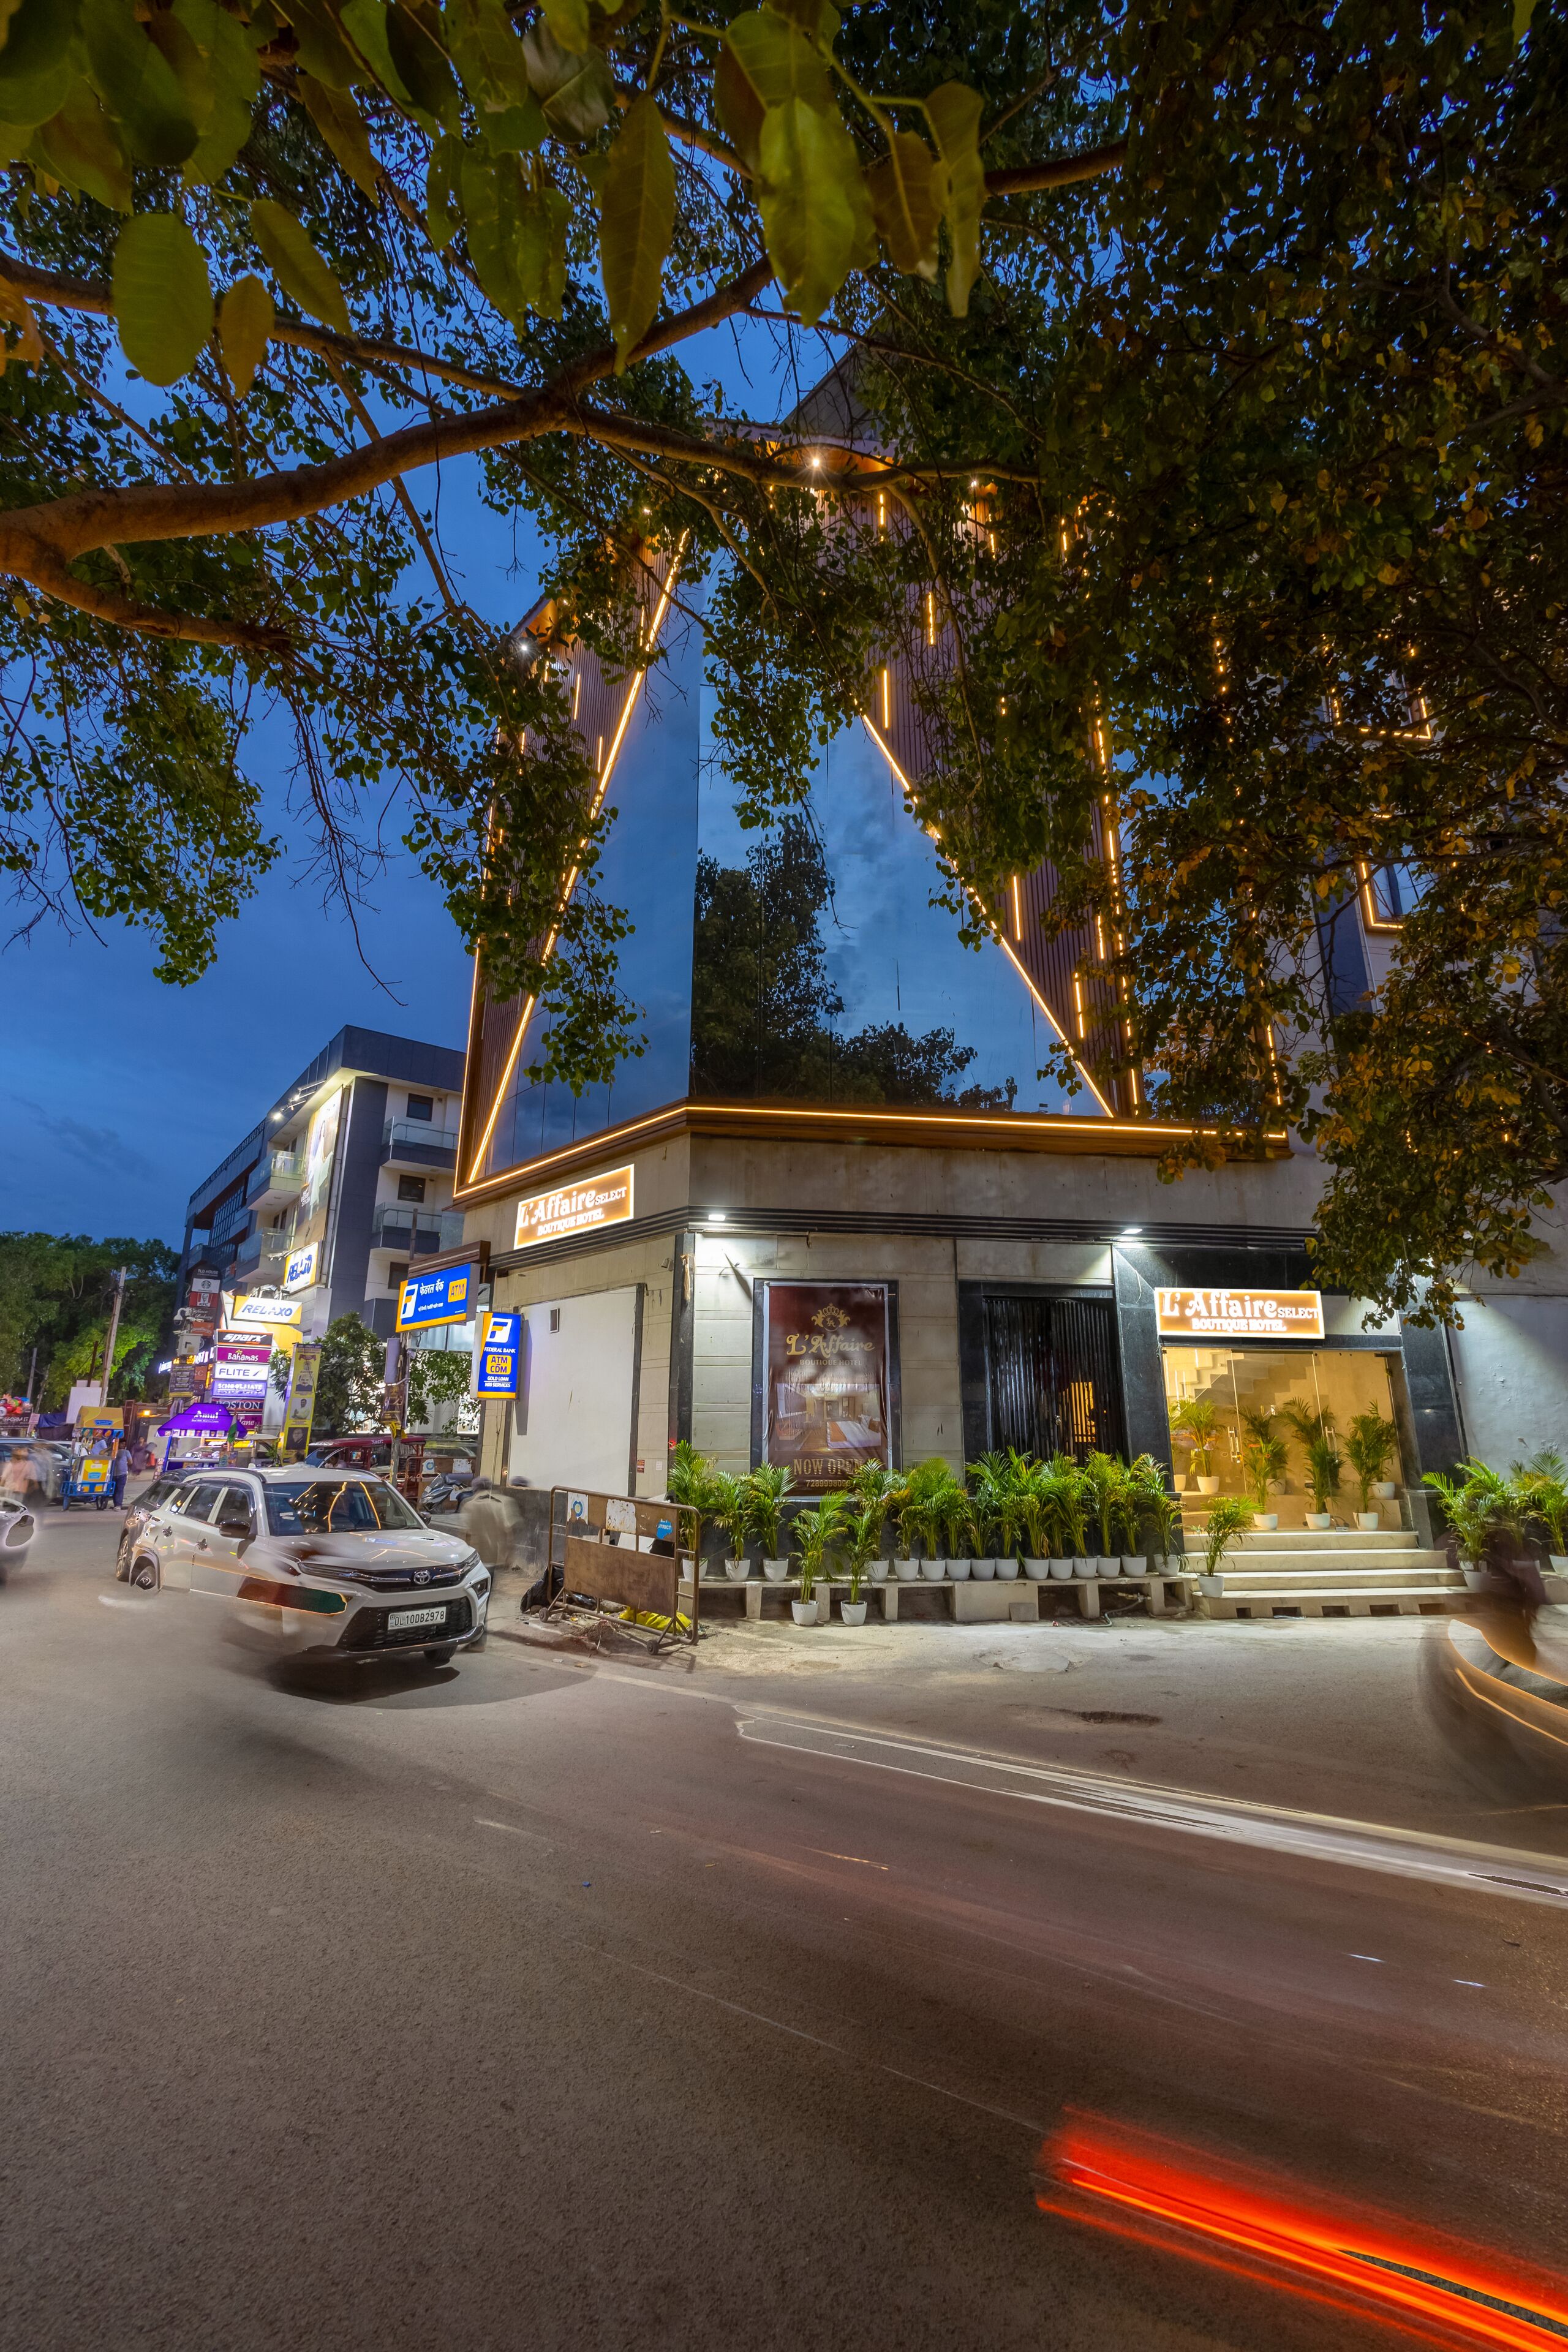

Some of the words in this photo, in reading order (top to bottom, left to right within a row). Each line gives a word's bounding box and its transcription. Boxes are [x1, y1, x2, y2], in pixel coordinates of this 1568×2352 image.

[520, 1190, 596, 1226] L'Affaire
[595, 1187, 627, 1205] SELECT
[537, 1216, 576, 1236] BOUTIQUE
[576, 1208, 605, 1226] HOTEL
[450, 1283, 465, 1297] ATM
[241, 1304, 293, 1316] RELAXO
[1278, 1308, 1320, 1319] SELECT
[1192, 1318, 1249, 1332] BOUTIQUE
[1249, 1319, 1287, 1332] HOTEL
[786, 1333, 875, 1359] L'Affaire
[227, 1352, 258, 1362] Bahamas
[793, 1459, 824, 1475] NOW
